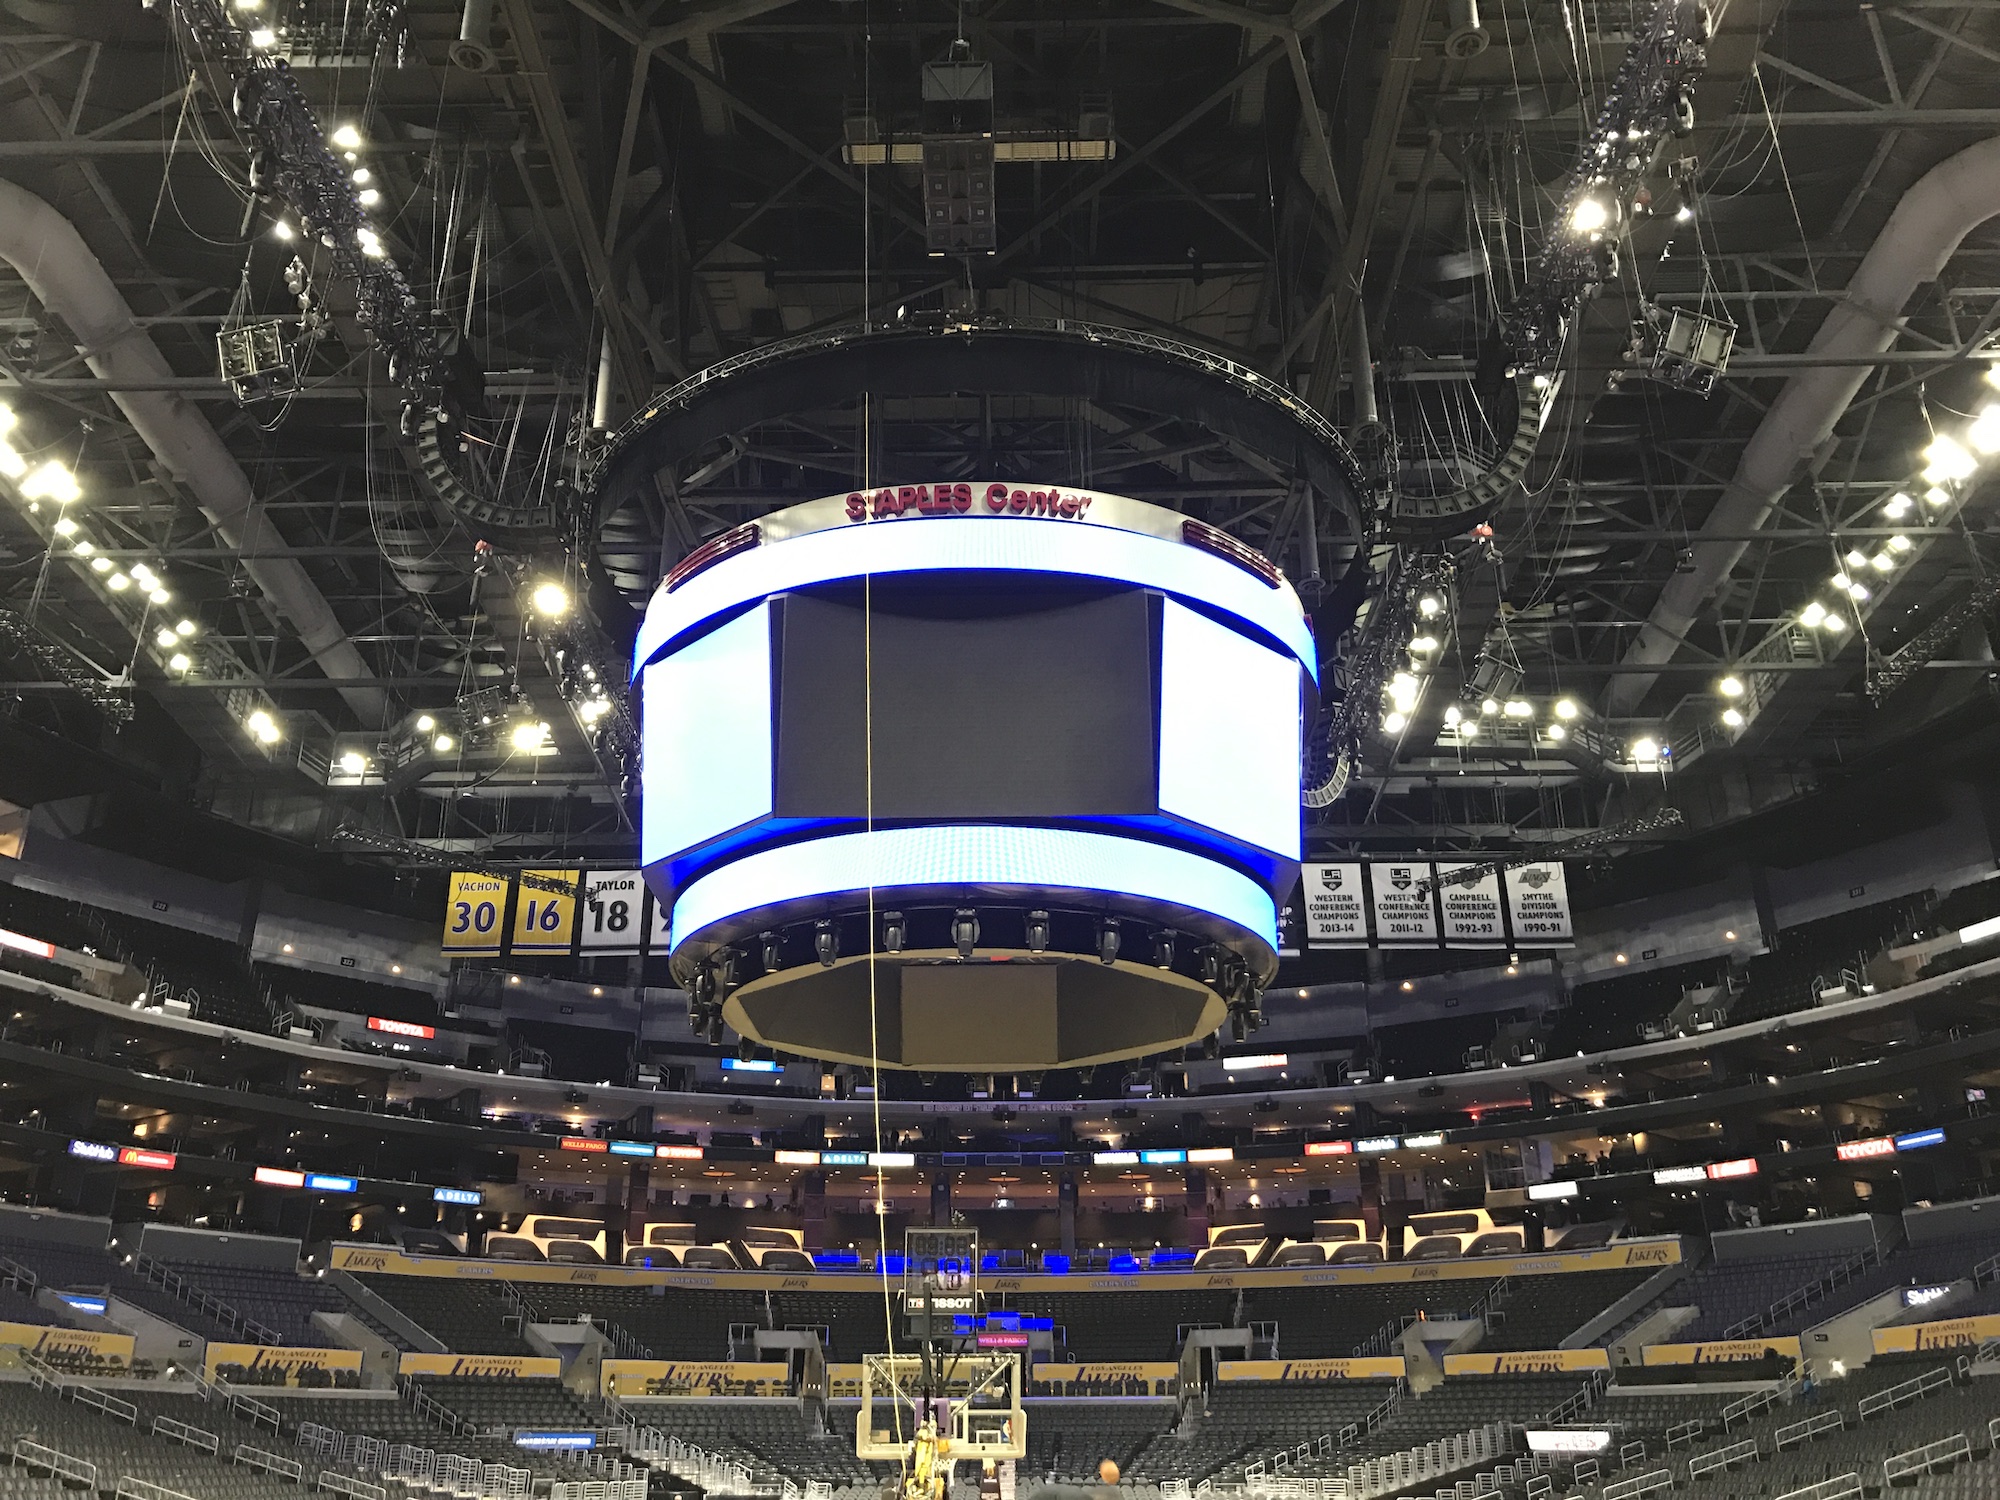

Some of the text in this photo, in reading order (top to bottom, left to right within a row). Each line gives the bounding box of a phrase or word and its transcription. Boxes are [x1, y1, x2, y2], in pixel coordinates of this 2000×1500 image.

[846, 484, 1092, 520] STAPLES Center
[1523, 872, 1549, 882] KINGS
[458, 882, 500, 892] VACHON
[596, 880, 635, 890] TAYLOR
[1314, 894, 1353, 902] WESTERN
[1384, 894, 1418, 902] WESTER
[1522, 893, 1554, 901] SMYTHE
[1309, 903, 1360, 911] CONFERENCE
[1378, 903, 1431, 911] CONFERENCE
[1521, 902, 1557, 910] DIVISION
[451, 901, 496, 933] 30
[526, 900, 560, 931] 16
[594, 901, 629, 933] 18
[1312, 912, 1359, 920] CHAMPIONS
[1382, 912, 1429, 920] CHAMPIONS
[1449, 912, 1496, 920] CHAMPIONS
[1517, 912, 1564, 920] CHAMPIONS
[1319, 924, 1355, 933] 2013-14
[1390, 924, 1424, 933] 2011-12
[1455, 924, 1493, 933] 1992-93
[1524, 923, 1561, 932] 1990-91
[378, 1019, 425, 1037] TOYOTA
[73, 1140, 114, 1159] StubHub
[562, 1141, 585, 1149] WELLS
[586, 1142, 608, 1150] FARGO
[1837, 1139, 1895, 1159] TOYOTA
[833, 1154, 866, 1163] DELTA
[446, 1191, 480, 1203] DELTA
[1625, 1247, 1669, 1264] LAKERS
[343, 1251, 388, 1270] LAKERS
[1927, 1321, 1975, 1334] LOS ANGELES
[53, 1332, 101, 1343] LOS ANGELES
